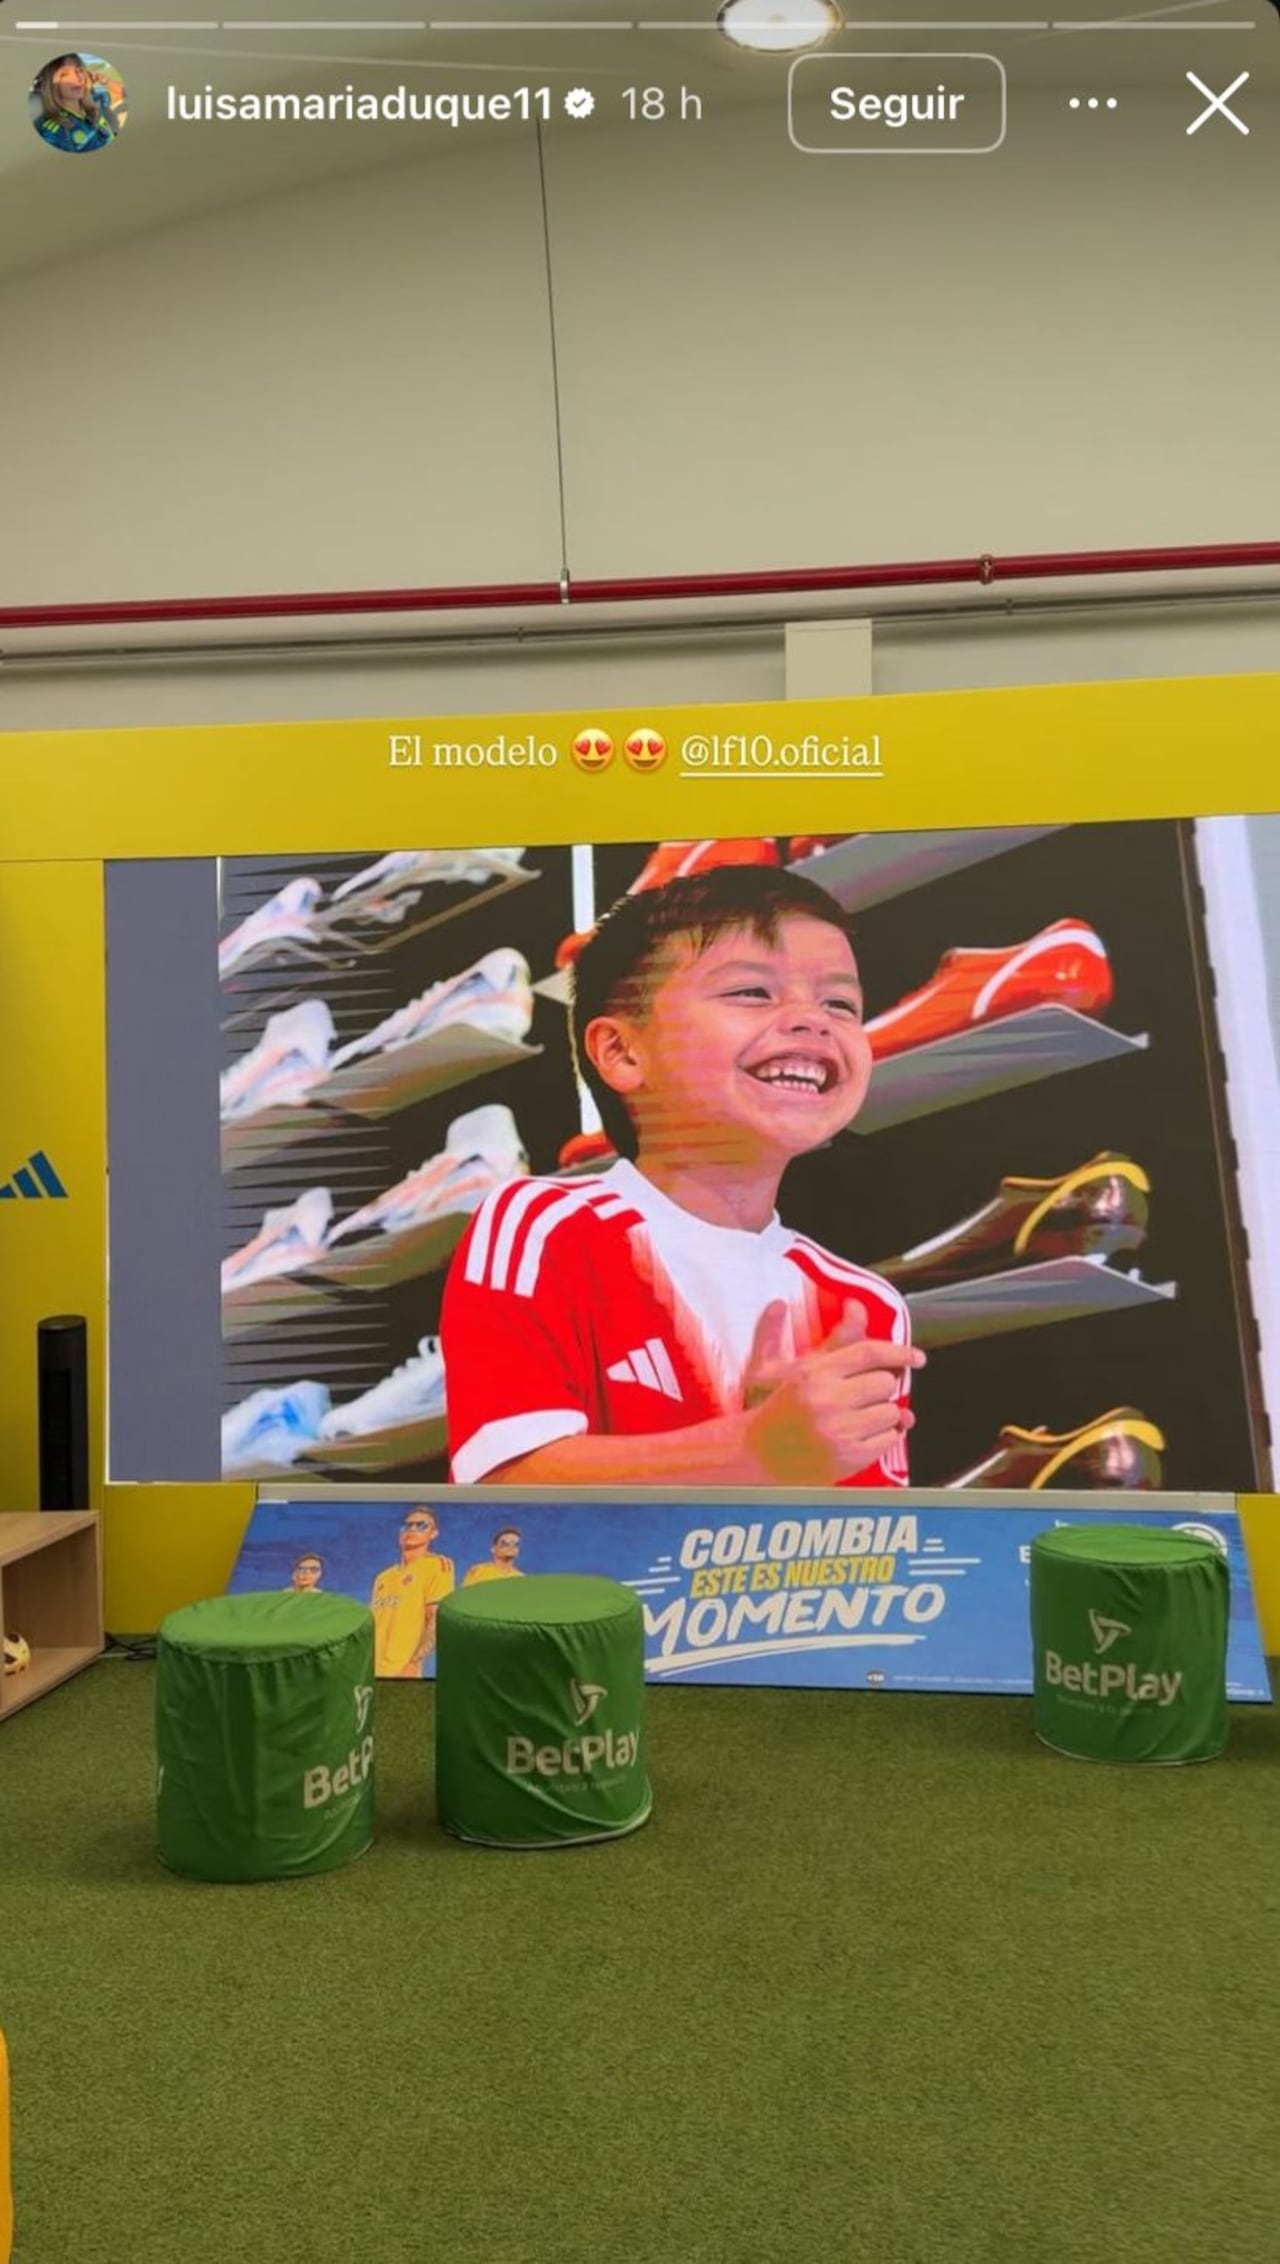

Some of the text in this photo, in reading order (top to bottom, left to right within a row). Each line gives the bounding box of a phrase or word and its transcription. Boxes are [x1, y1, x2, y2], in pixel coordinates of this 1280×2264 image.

[679, 1515, 918, 1570] COLOMBIA
[690, 1554, 896, 1599] ESTE ES NUESTRO
[642, 1583, 946, 1657] MOMENTO
[1045, 1650, 1183, 1707] BetPlay
